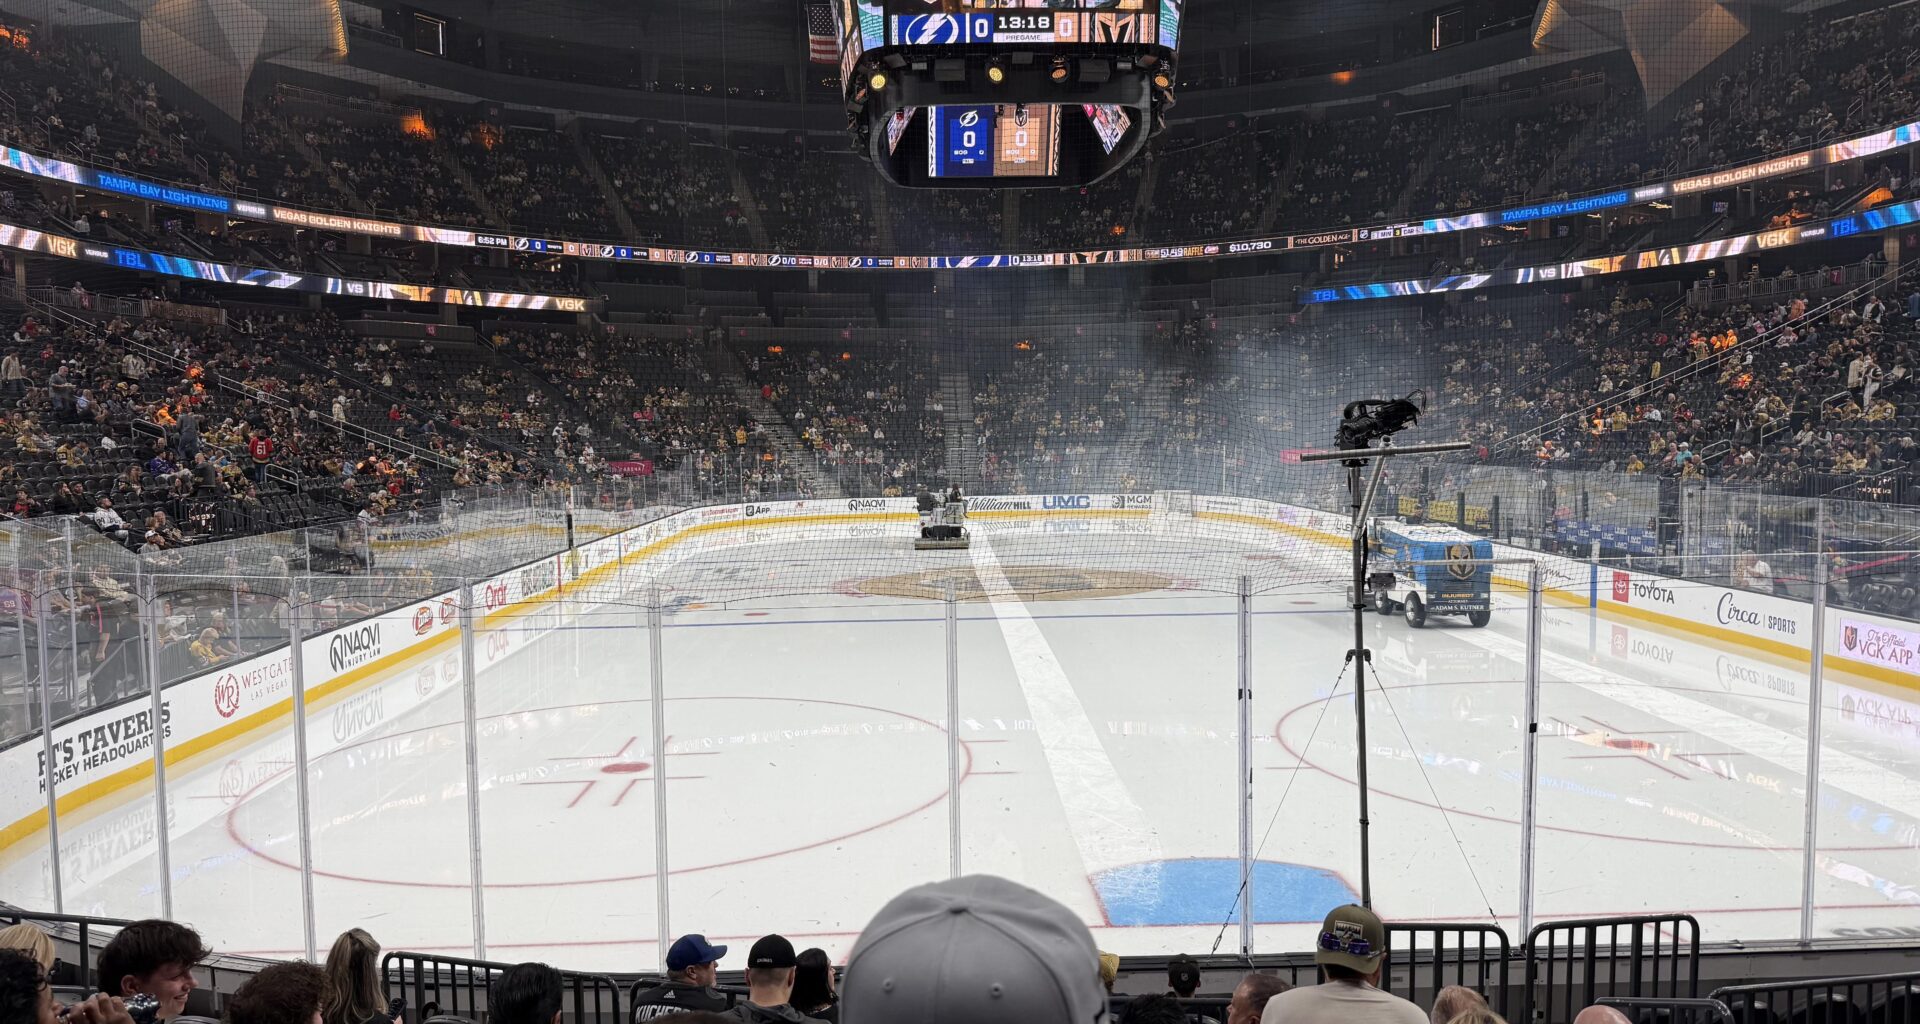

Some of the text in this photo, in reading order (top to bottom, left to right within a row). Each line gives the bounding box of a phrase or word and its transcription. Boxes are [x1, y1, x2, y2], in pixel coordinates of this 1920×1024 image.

[975, 19, 988, 37] 0
[998, 17, 1050, 29] 13:18
[1059, 18, 1072, 37] 0
[963, 131, 976, 147] 0
[1015, 131, 1028, 147] 0
[1673, 155, 1809, 193] VEGAS GOLDEN KNIGHTS
[98, 174, 228, 211] TAMPA BAY LIGHTNING
[1634, 187, 1664, 198] VERSUS
[236, 203, 265, 215] VERSUS
[1501, 193, 1627, 222] TAMPA BAY LIGHTNING
[273, 208, 401, 235] VEGAS GOLDEN KNIGHTS
[1832, 219, 1861, 237] TBL
[1308, 235, 1338, 245] GOLDEN
[1757, 231, 1790, 249] VGK
[1800, 227, 1825, 238] VERSUS
[47, 235, 77, 257] VGK
[477, 236, 508, 247] 6:52 PM
[535, 241, 541, 250] 0
[1229, 241, 1272, 253] $10,730
[85, 248, 109, 259] VERSUS
[115, 249, 146, 269] TBL
[621, 249, 626, 257] 0
[654, 251, 660, 259] 0
[704, 254, 710, 262] 0
[738, 255, 744, 263] 0
[1184, 246, 1204, 257] RAFFLE
[782, 257, 797, 265] 0/0
[814, 258, 828, 266] 0/0
[867, 258, 873, 266] 0
[1012, 256, 1020, 265] 0
[1046, 256, 1053, 264] 0
[1539, 267, 1556, 279] VS
[346, 283, 364, 294] VS
[1313, 288, 1340, 303] TBL
[555, 297, 585, 311] VGK
[256, 444, 267, 455] 61
[858, 499, 886, 509] NAQVI
[968, 496, 1032, 511] William HILL
[1042, 495, 1091, 510] UMC
[1127, 495, 1152, 504] MGM
[1632, 582, 1675, 604] TOYOTA
[1717, 592, 1796, 635] Circa SPORTS
[343, 622, 381, 659] NAQVI
[1867, 629, 1882, 642] The
[345, 647, 382, 669] INJURY LAW
[1859, 639, 1913, 665] VGK APP
[241, 657, 293, 689] WESTGATE
[250, 679, 289, 701] LAS VEGAS
[78, 701, 171, 756] TAVERS
[39, 725, 172, 795] HCKEY HEADQUARTRS
